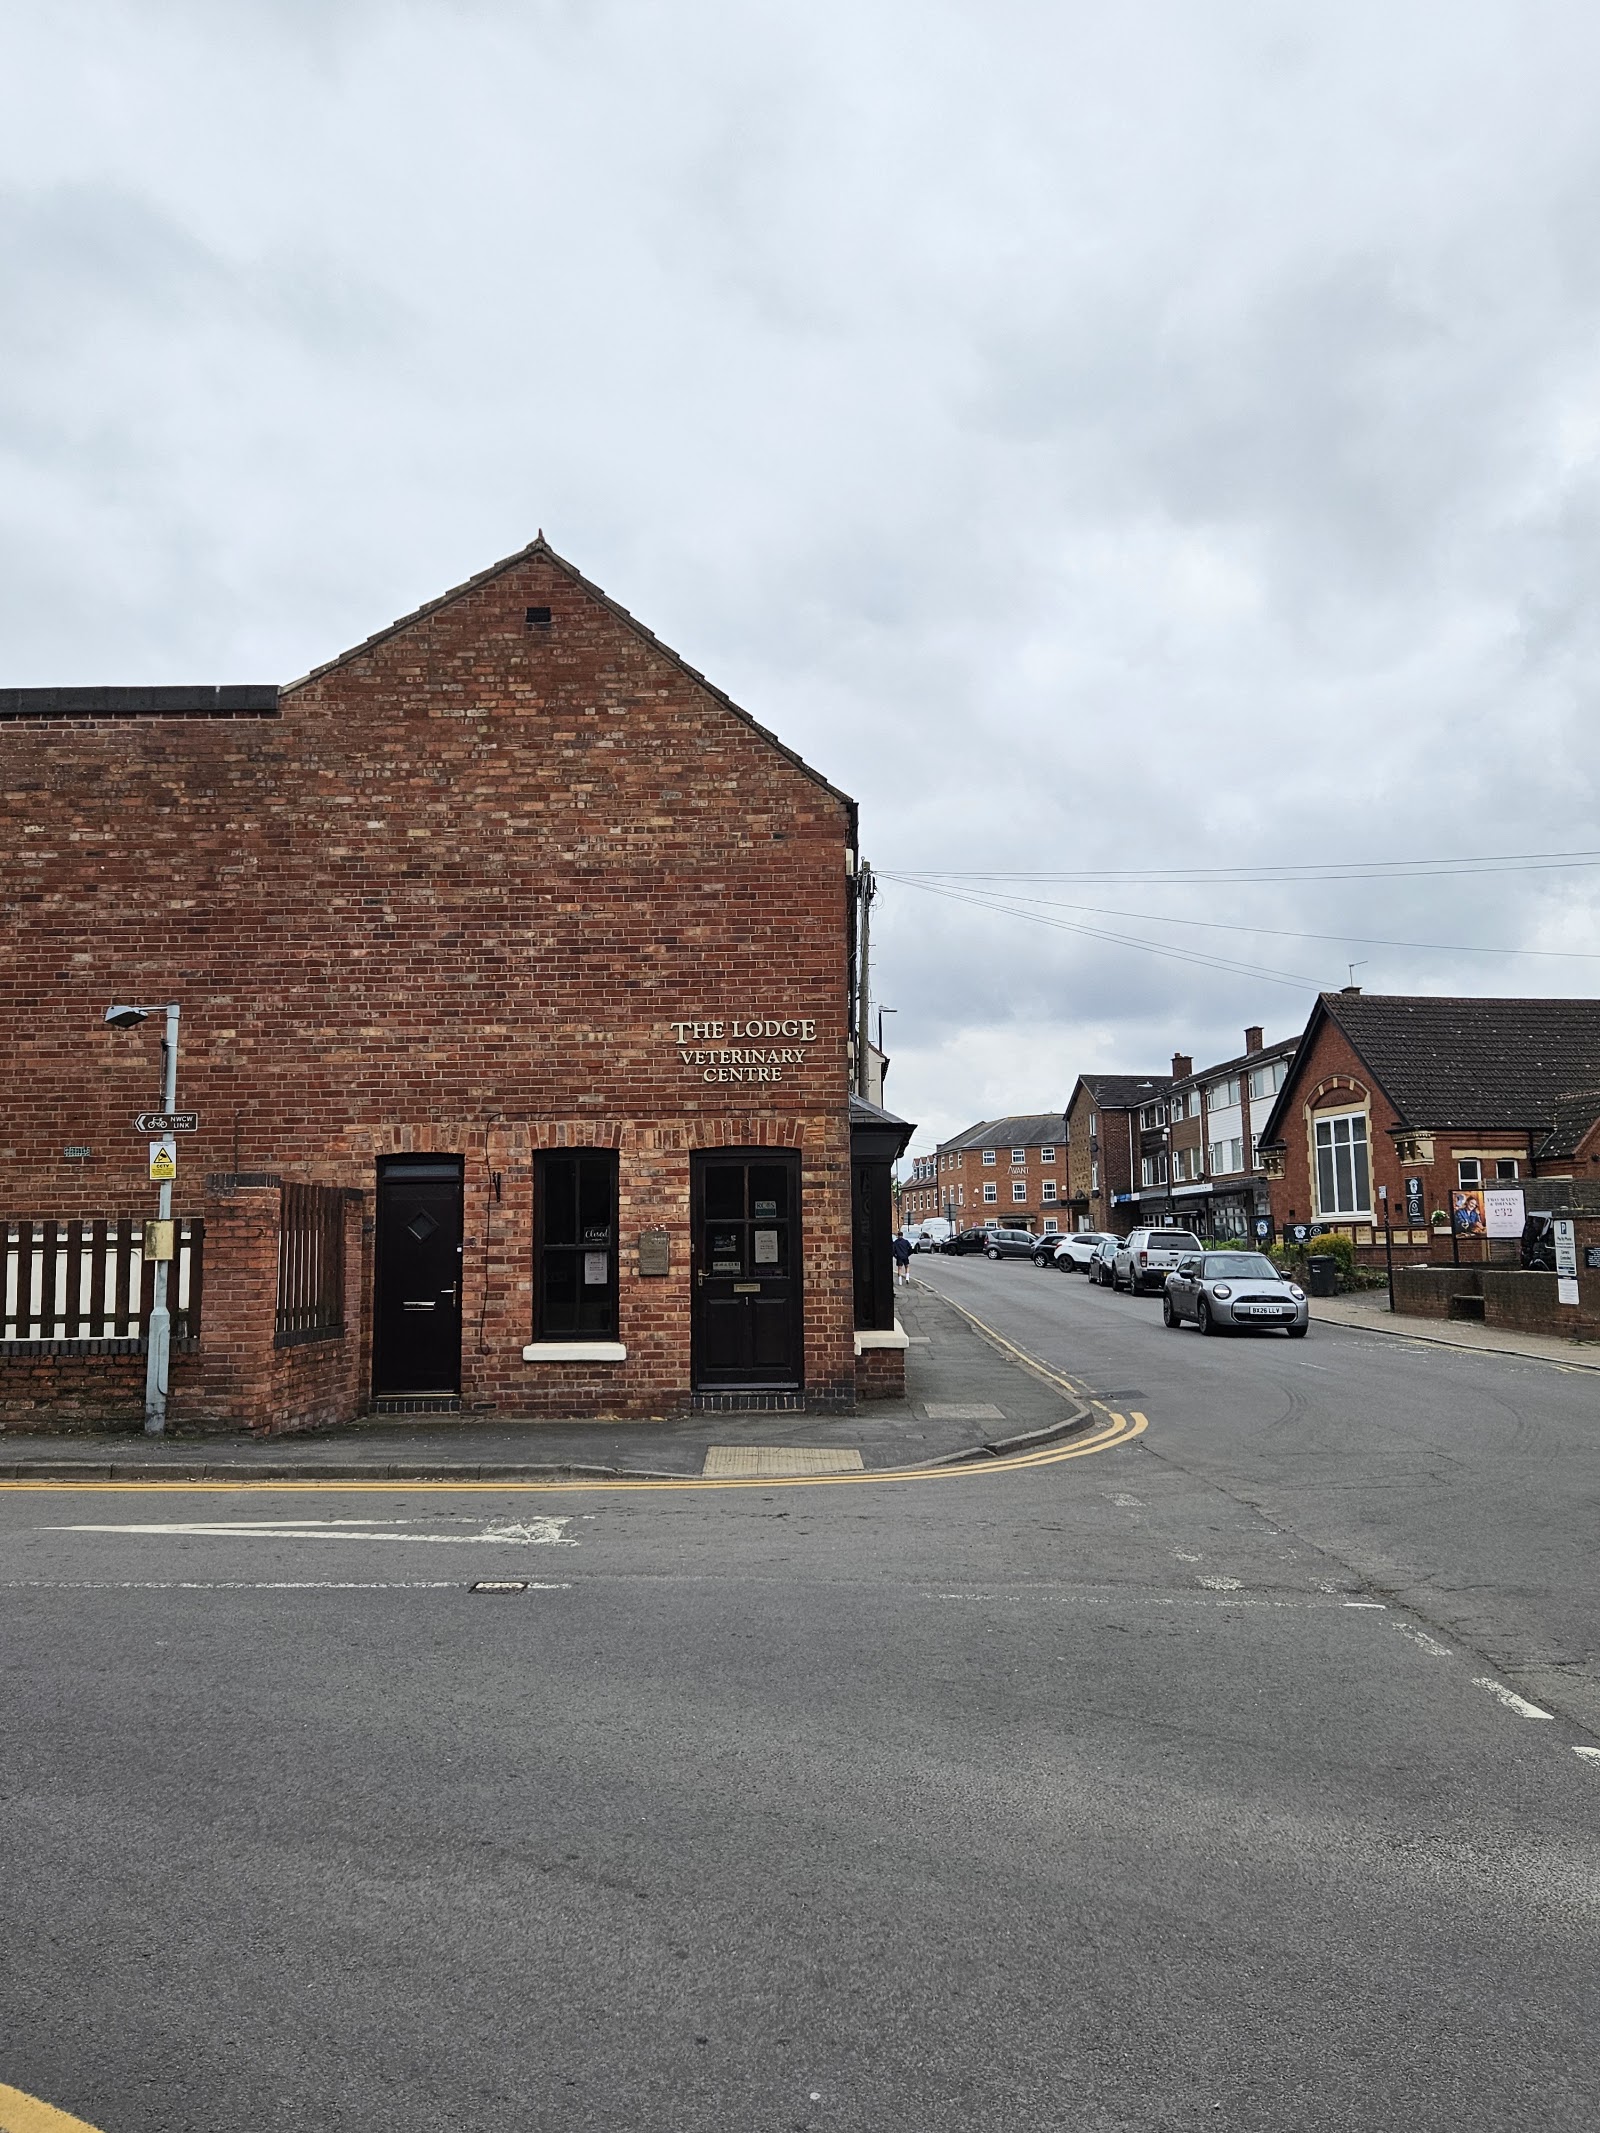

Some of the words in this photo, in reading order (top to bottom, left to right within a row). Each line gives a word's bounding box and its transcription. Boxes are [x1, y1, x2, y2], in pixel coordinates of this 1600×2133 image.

[670, 1021, 725, 1044] THE
[731, 1019, 817, 1042] LODGE
[680, 1048, 806, 1065] VETERINARY
[703, 1067, 782, 1083] CENTRE
[1006, 1165, 1029, 1174] AVANT
[1494, 1207, 1513, 1217] £32
[585, 1228, 608, 1238] Closed
